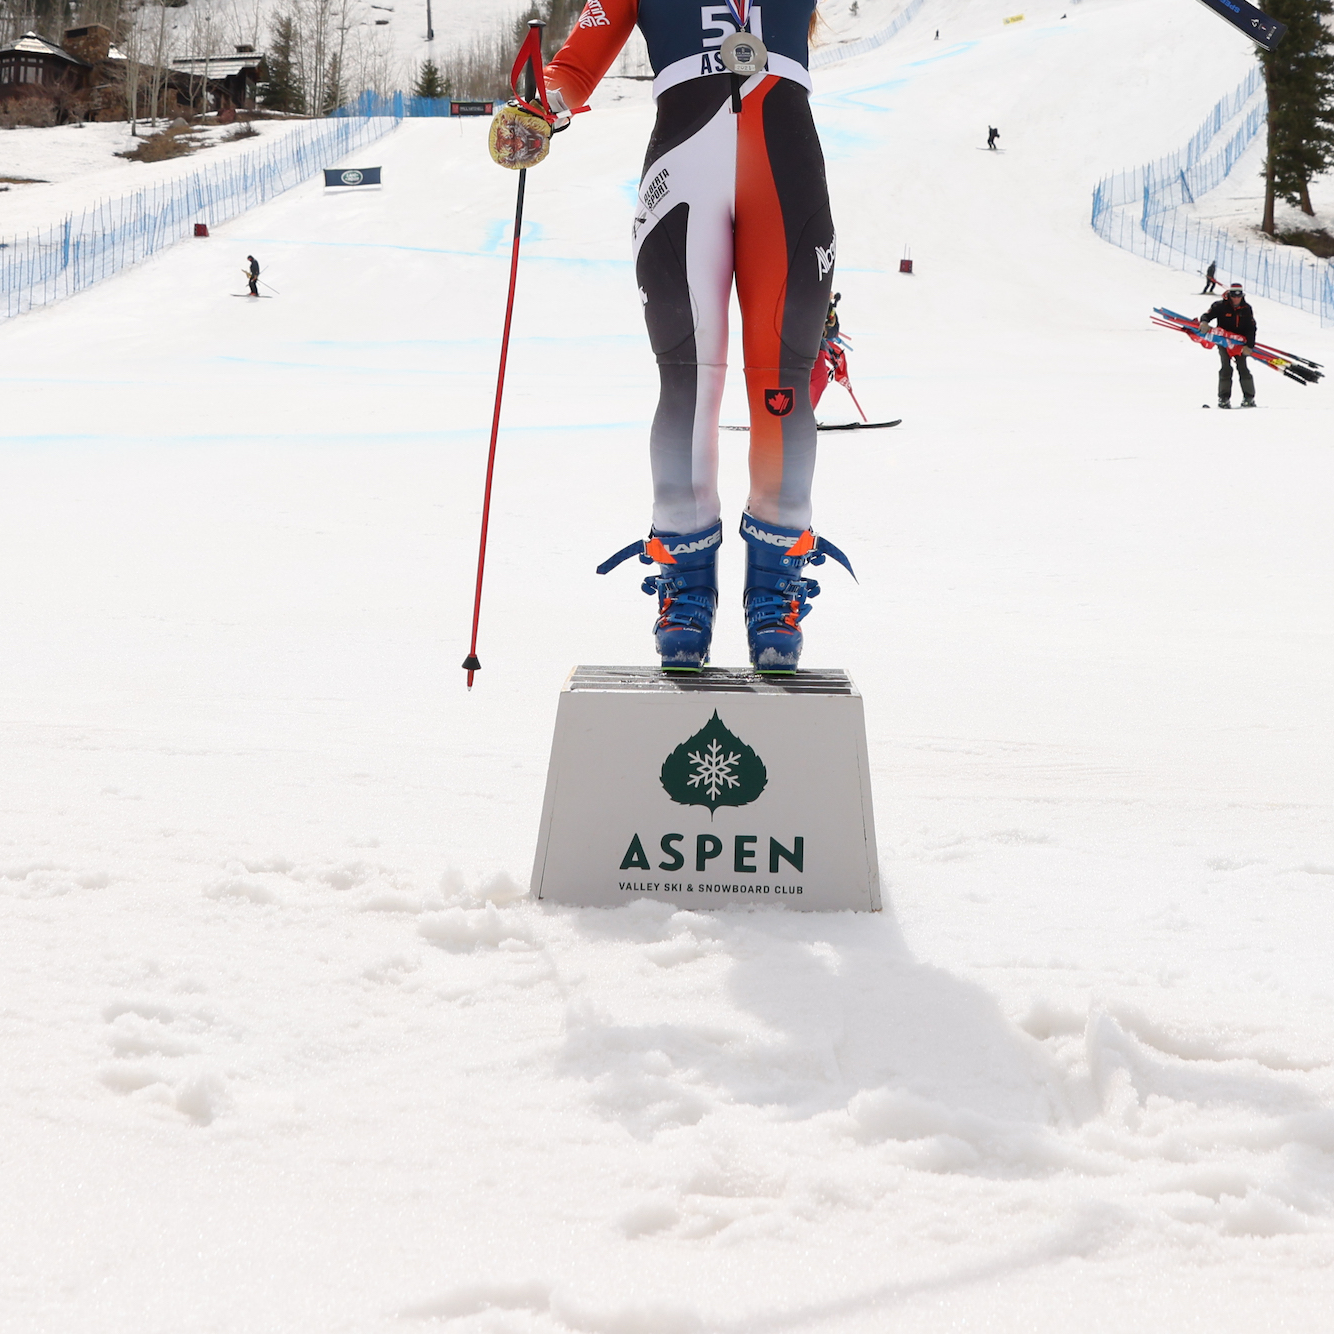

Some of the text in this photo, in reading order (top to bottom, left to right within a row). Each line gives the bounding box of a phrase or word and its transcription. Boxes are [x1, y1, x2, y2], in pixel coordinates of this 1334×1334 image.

[701, 5, 764, 48] 51
[643, 168, 670, 203] ALBERTA
[647, 180, 669, 209] SPORT
[665, 529, 721, 555] LANGE
[742, 519, 801, 548] LANGE
[619, 832, 804, 874] ASPEN
[619, 882, 803, 894] VALLEY SKI & SNOWBOARD CLUB
